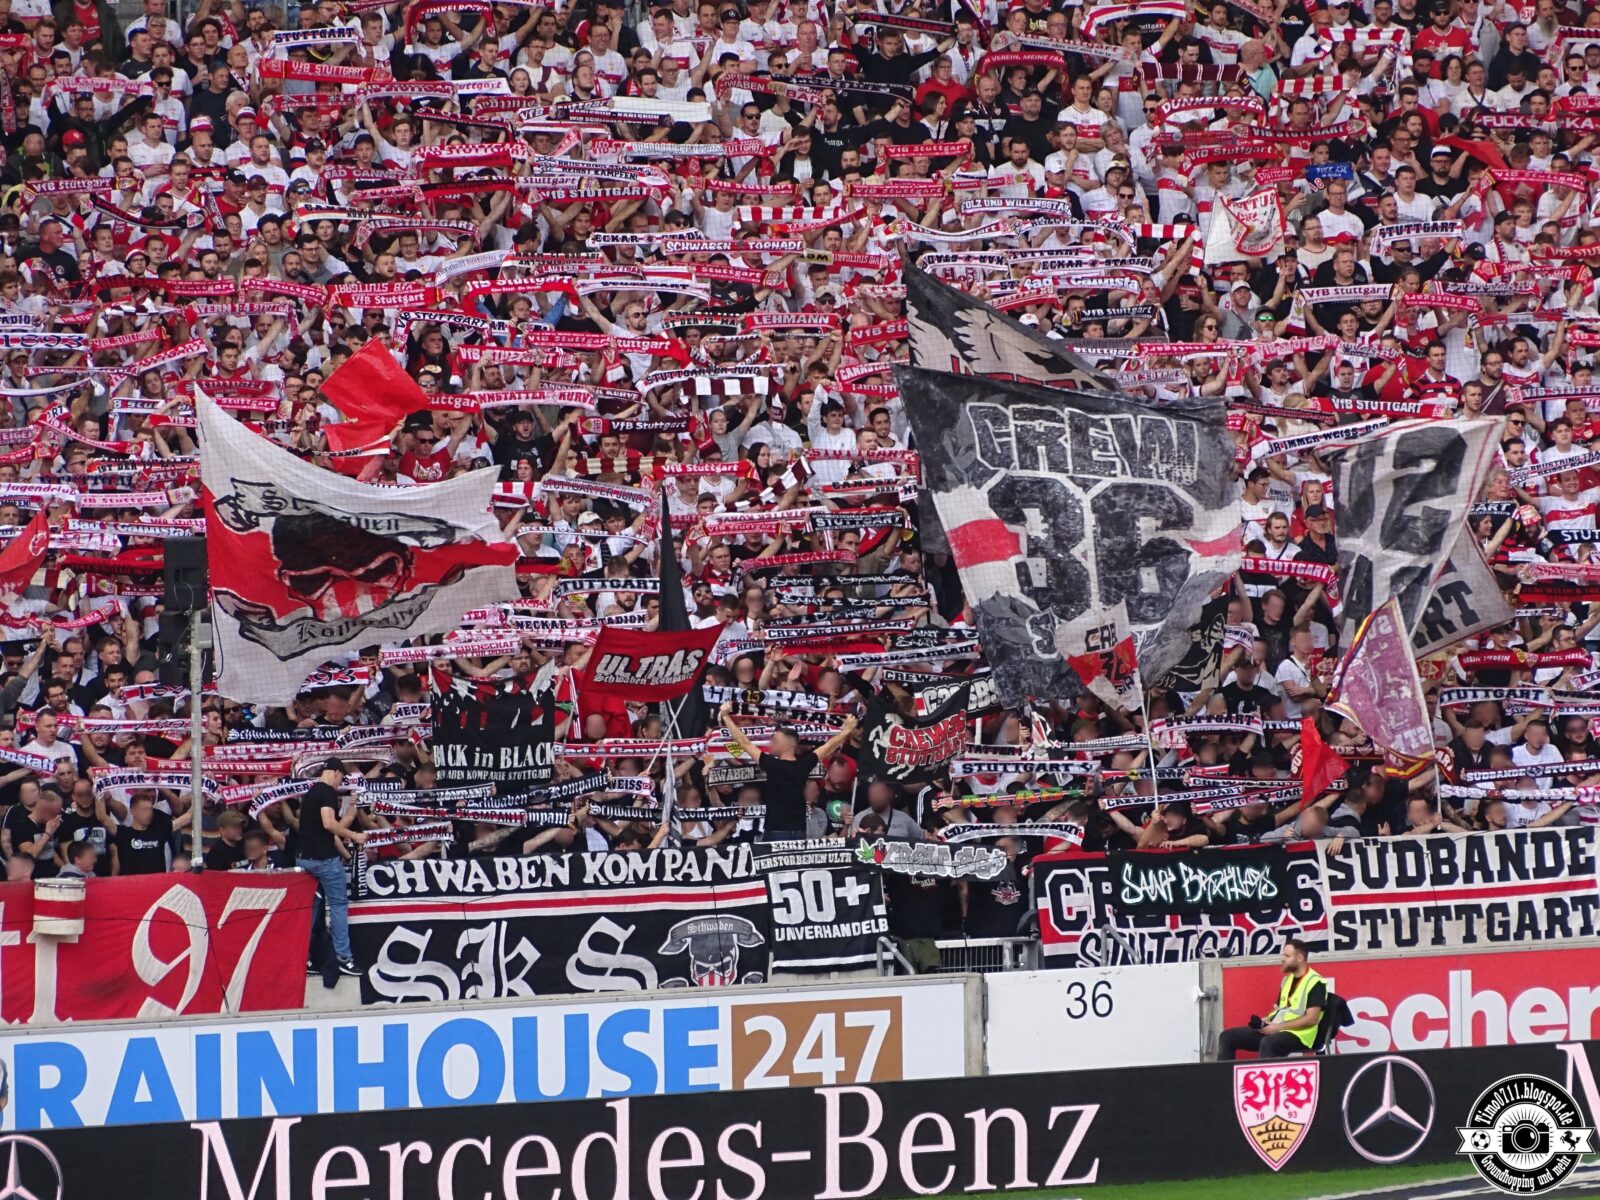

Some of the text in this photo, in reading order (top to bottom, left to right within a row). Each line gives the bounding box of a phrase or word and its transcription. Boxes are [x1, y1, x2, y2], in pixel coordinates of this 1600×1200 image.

[274, 28, 354, 43] STUTTGART
[314, 64, 366, 77] STUTTGART
[456, 81, 502, 89] uttgart
[1483, 116, 1526, 127] FUCK
[1258, 170, 1293, 180] STUTTGART
[58, 178, 112, 193] Stuttgart
[569, 187, 648, 198] STUTTGART
[1379, 222, 1457, 236] STUTTGART
[595, 234, 639, 243] ECKAR
[666, 242, 731, 251] SCHWABEN
[1041, 261, 1082, 269] ECKAR
[352, 293, 424, 304] VfB Stuttgart
[1306, 285, 1388, 298] VfB Stuttgart
[1107, 305, 1152, 315] Stuttgart
[414, 311, 487, 327] STUTTGART
[754, 314, 830, 324] LEHMANN
[3, 335, 83, 347] 1893
[617, 338, 670, 350] tuttgart
[479, 390, 594, 405] NNSTATTER KURVE
[1332, 399, 1423, 412] VfB STUTTGART
[612, 420, 686, 431] VfB Stuttgart
[967, 403, 1199, 484] CREW
[1284, 435, 1320, 450] IMMER
[686, 463, 738, 472] Stuttgart
[816, 516, 899, 526] STUTTGART
[987, 475, 1195, 626] 36
[1260, 560, 1328, 579] STUTTGART
[516, 612, 646, 629] NECKAR STADION
[596, 649, 703, 679] ULTRAS
[593, 674, 647, 684] Schwaben
[885, 671, 929, 681] CREW
[1165, 716, 1255, 727] STUTTGART
[338, 727, 385, 747] NECKAR
[474, 748, 493, 767] in
[500, 742, 555, 768] BLACK
[508, 769, 551, 780] STUTTGART
[962, 763, 1070, 773] STUTTGART
[96, 775, 144, 793] NECKAR
[808, 838, 846, 849] ALLEN
[754, 854, 826, 870] VERSTORBENEN
[1326, 826, 1596, 891] SÜDBANDE
[366, 853, 570, 897] CHWABEN
[768, 870, 886, 924] 50+
[686, 920, 735, 934] Schwaben
[1333, 894, 1600, 951] STUTTGART
[774, 918, 888, 942] UNVERHANDELB
[131, 883, 287, 1019] 97
[1066, 980, 1114, 1019] 36
[1336, 970, 1600, 1056] scher
[13, 1007, 891, 1131] RAINHOUSE 247
[1241, 1068, 1313, 1112] VfB
[1256, 1111, 1298, 1120] 18 93
[190, 1085, 1101, 1200] Mercedes-Benz
